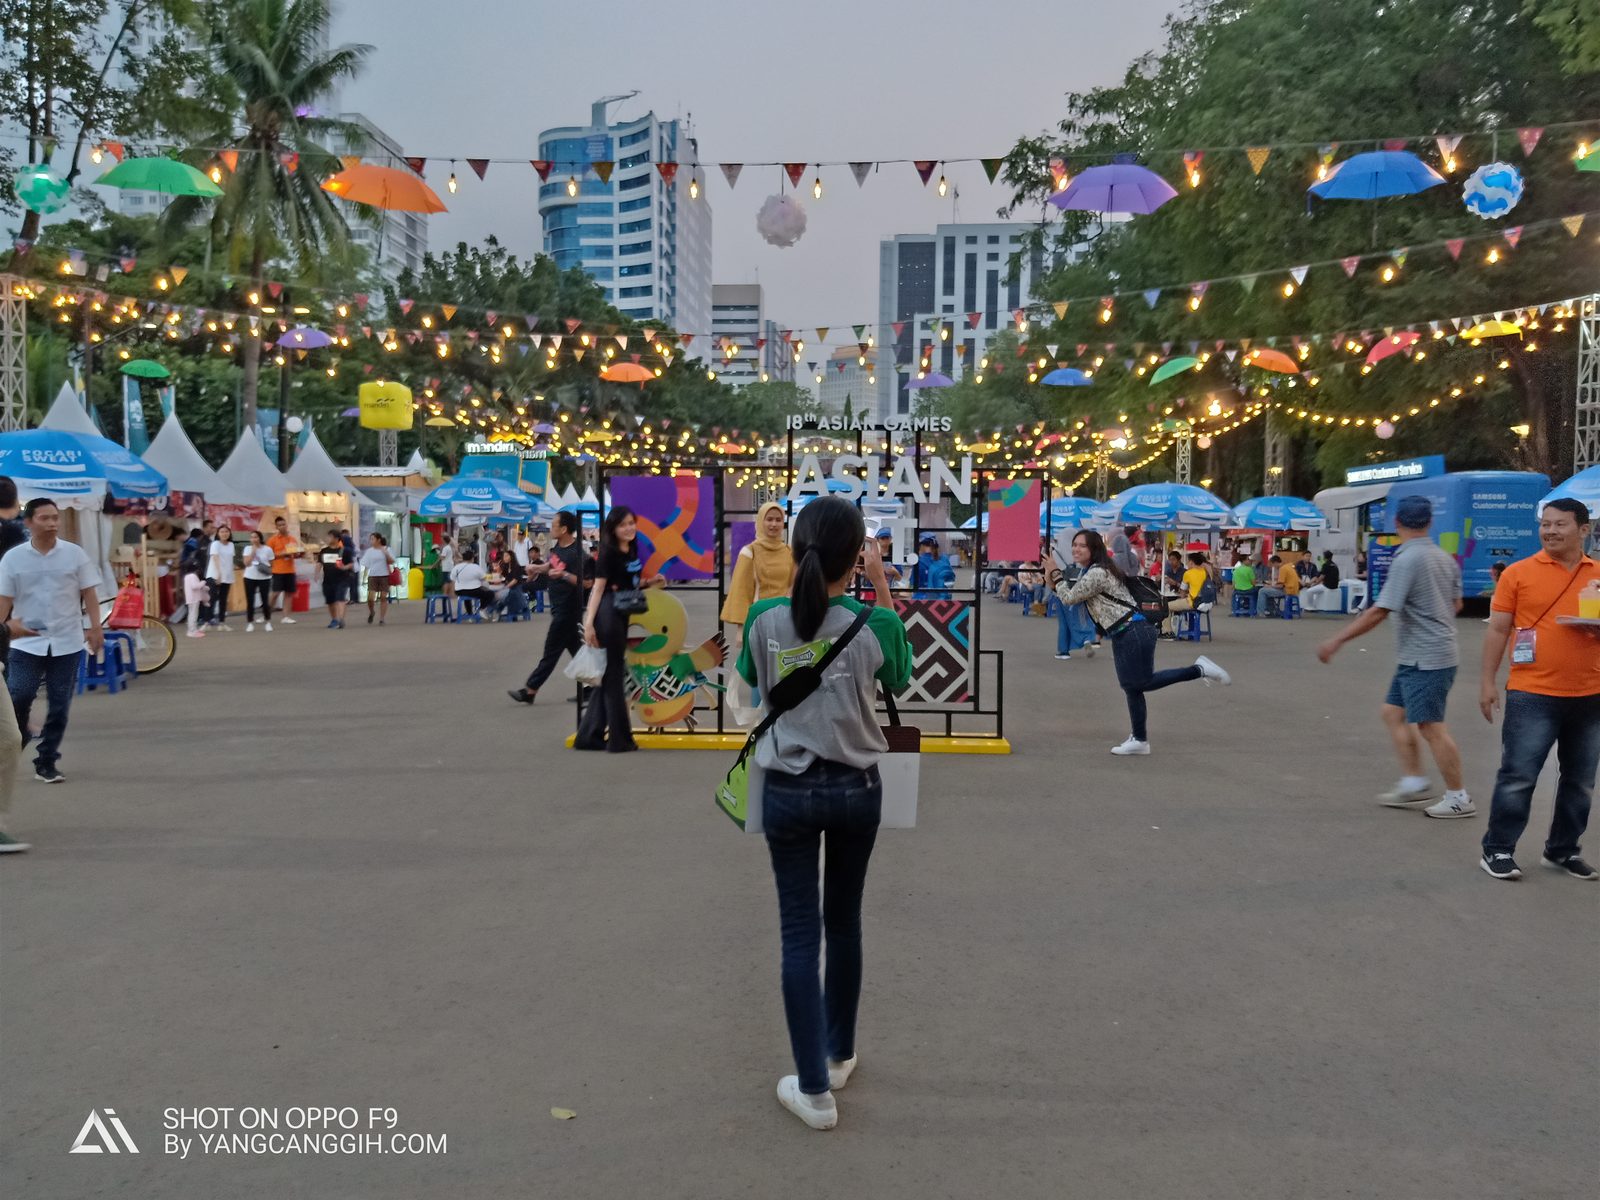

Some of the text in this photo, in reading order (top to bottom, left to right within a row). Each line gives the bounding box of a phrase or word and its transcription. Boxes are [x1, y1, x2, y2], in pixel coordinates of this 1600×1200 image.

[818, 415, 875, 431] ASIAN
[884, 416, 952, 432] GAMES
[467, 441, 514, 453] mandiri
[23, 455, 77, 463] SWEAT
[787, 454, 972, 505] ASIAN
[1507, 502, 1534, 510] Service
